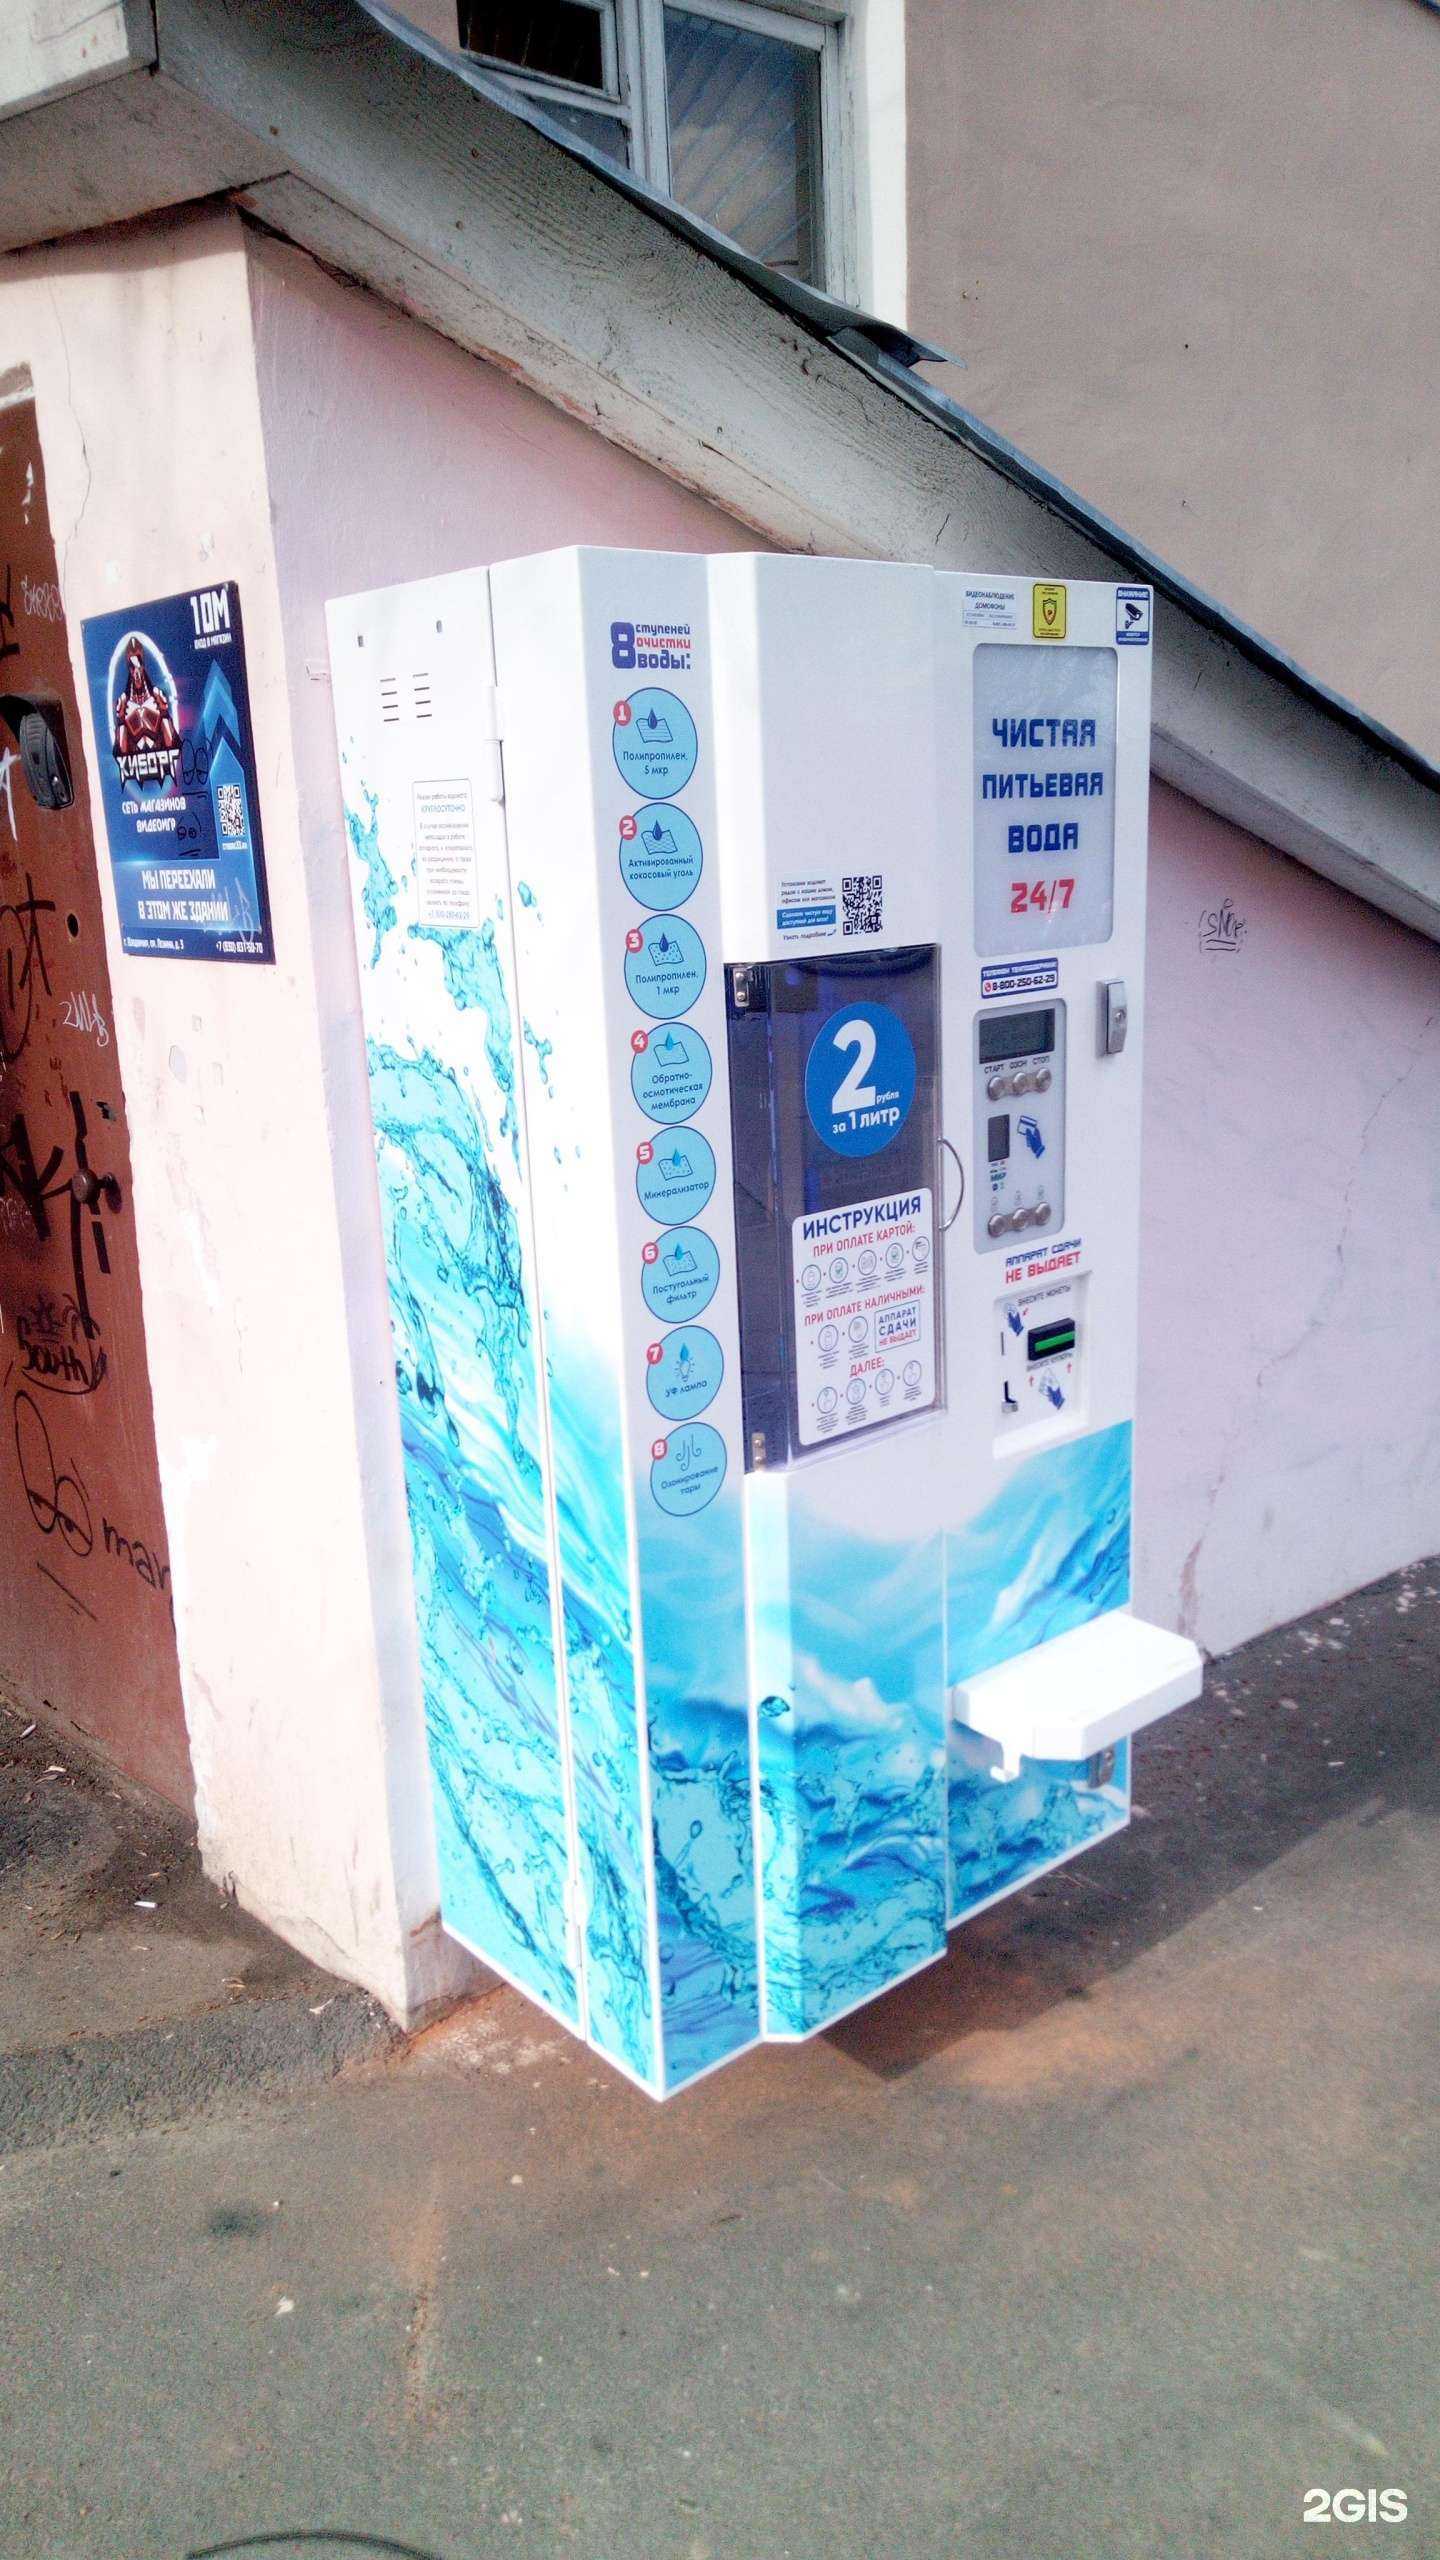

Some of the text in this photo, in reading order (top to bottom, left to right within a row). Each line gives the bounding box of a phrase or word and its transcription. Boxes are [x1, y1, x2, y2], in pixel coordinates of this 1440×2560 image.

[636, 624, 690, 636] ступеней
[610, 622, 636, 670] 8
[636, 637, 691, 649] очистки
[637, 650, 691, 670] воды:
[618, 704, 627, 721] 1
[992, 718, 1096, 748] ЧИСТАЯ
[117, 749, 180, 783] КИБОРГ
[644, 766, 668, 776] 5 мкр
[982, 772, 1104, 800] ПИТЬЕВАЯ
[122, 797, 186, 816] СЕТЬ МАГАЗИНОВ
[136, 818, 176, 833] ВИДЕОИГР
[622, 820, 634, 835] 2
[1008, 822, 1078, 854] ВОДА
[628, 856, 694, 868] Активированный
[142, 868, 216, 890] МЫ ПЕРЕЕХАЛИ
[630, 868, 693, 880] кокосовый уголь
[1010, 879, 1076, 914] 24/7
[138, 901, 229, 922] В ЭТОМ ЖЕ ЗДАНИИ
[629, 933, 640, 949] 3
[662, 984, 680, 996] мкр
[634, 1034, 645, 1050] 4
[832, 1019, 900, 1114] 2 рубля
[652, 1072, 693, 1084] Обратно-
[642, 1082, 703, 1099] осмотическая
[651, 1096, 696, 1111] мембрана
[832, 1106, 900, 1134] за 1 литр
[639, 1146, 650, 1161] 5
[644, 1181, 710, 1200] Минерализатор
[802, 1194, 922, 1240] ИНСТРУКЦИЯ
[813, 1220, 916, 1258] ПРИ ОПЛАТЕ КАРТОЙ:
[645, 1245, 655, 1261] 6
[1006, 1238, 1082, 1268] АППАРАТ СДАЧИ
[1006, 1251, 1080, 1284] НЕ ВЫДАЕТ
[653, 1274, 710, 1296] Постугольный
[666, 1290, 697, 1304] фильтр
[804, 1312, 824, 1327] ПРИ
[826, 1300, 862, 1320] ОПЛАТЕ
[865, 1284, 926, 1309] НАЛИЧНЫМИ:
[880, 1306, 916, 1324] АППАРАТ
[879, 1318, 917, 1336] СДАЧИ
[650, 1346, 660, 1362] 7
[850, 1356, 885, 1378] ДАЛЕЕ:
[679, 1380, 708, 1394] лампа
[655, 1440, 665, 1458] 8
[660, 1466, 719, 1490] Озонирование
